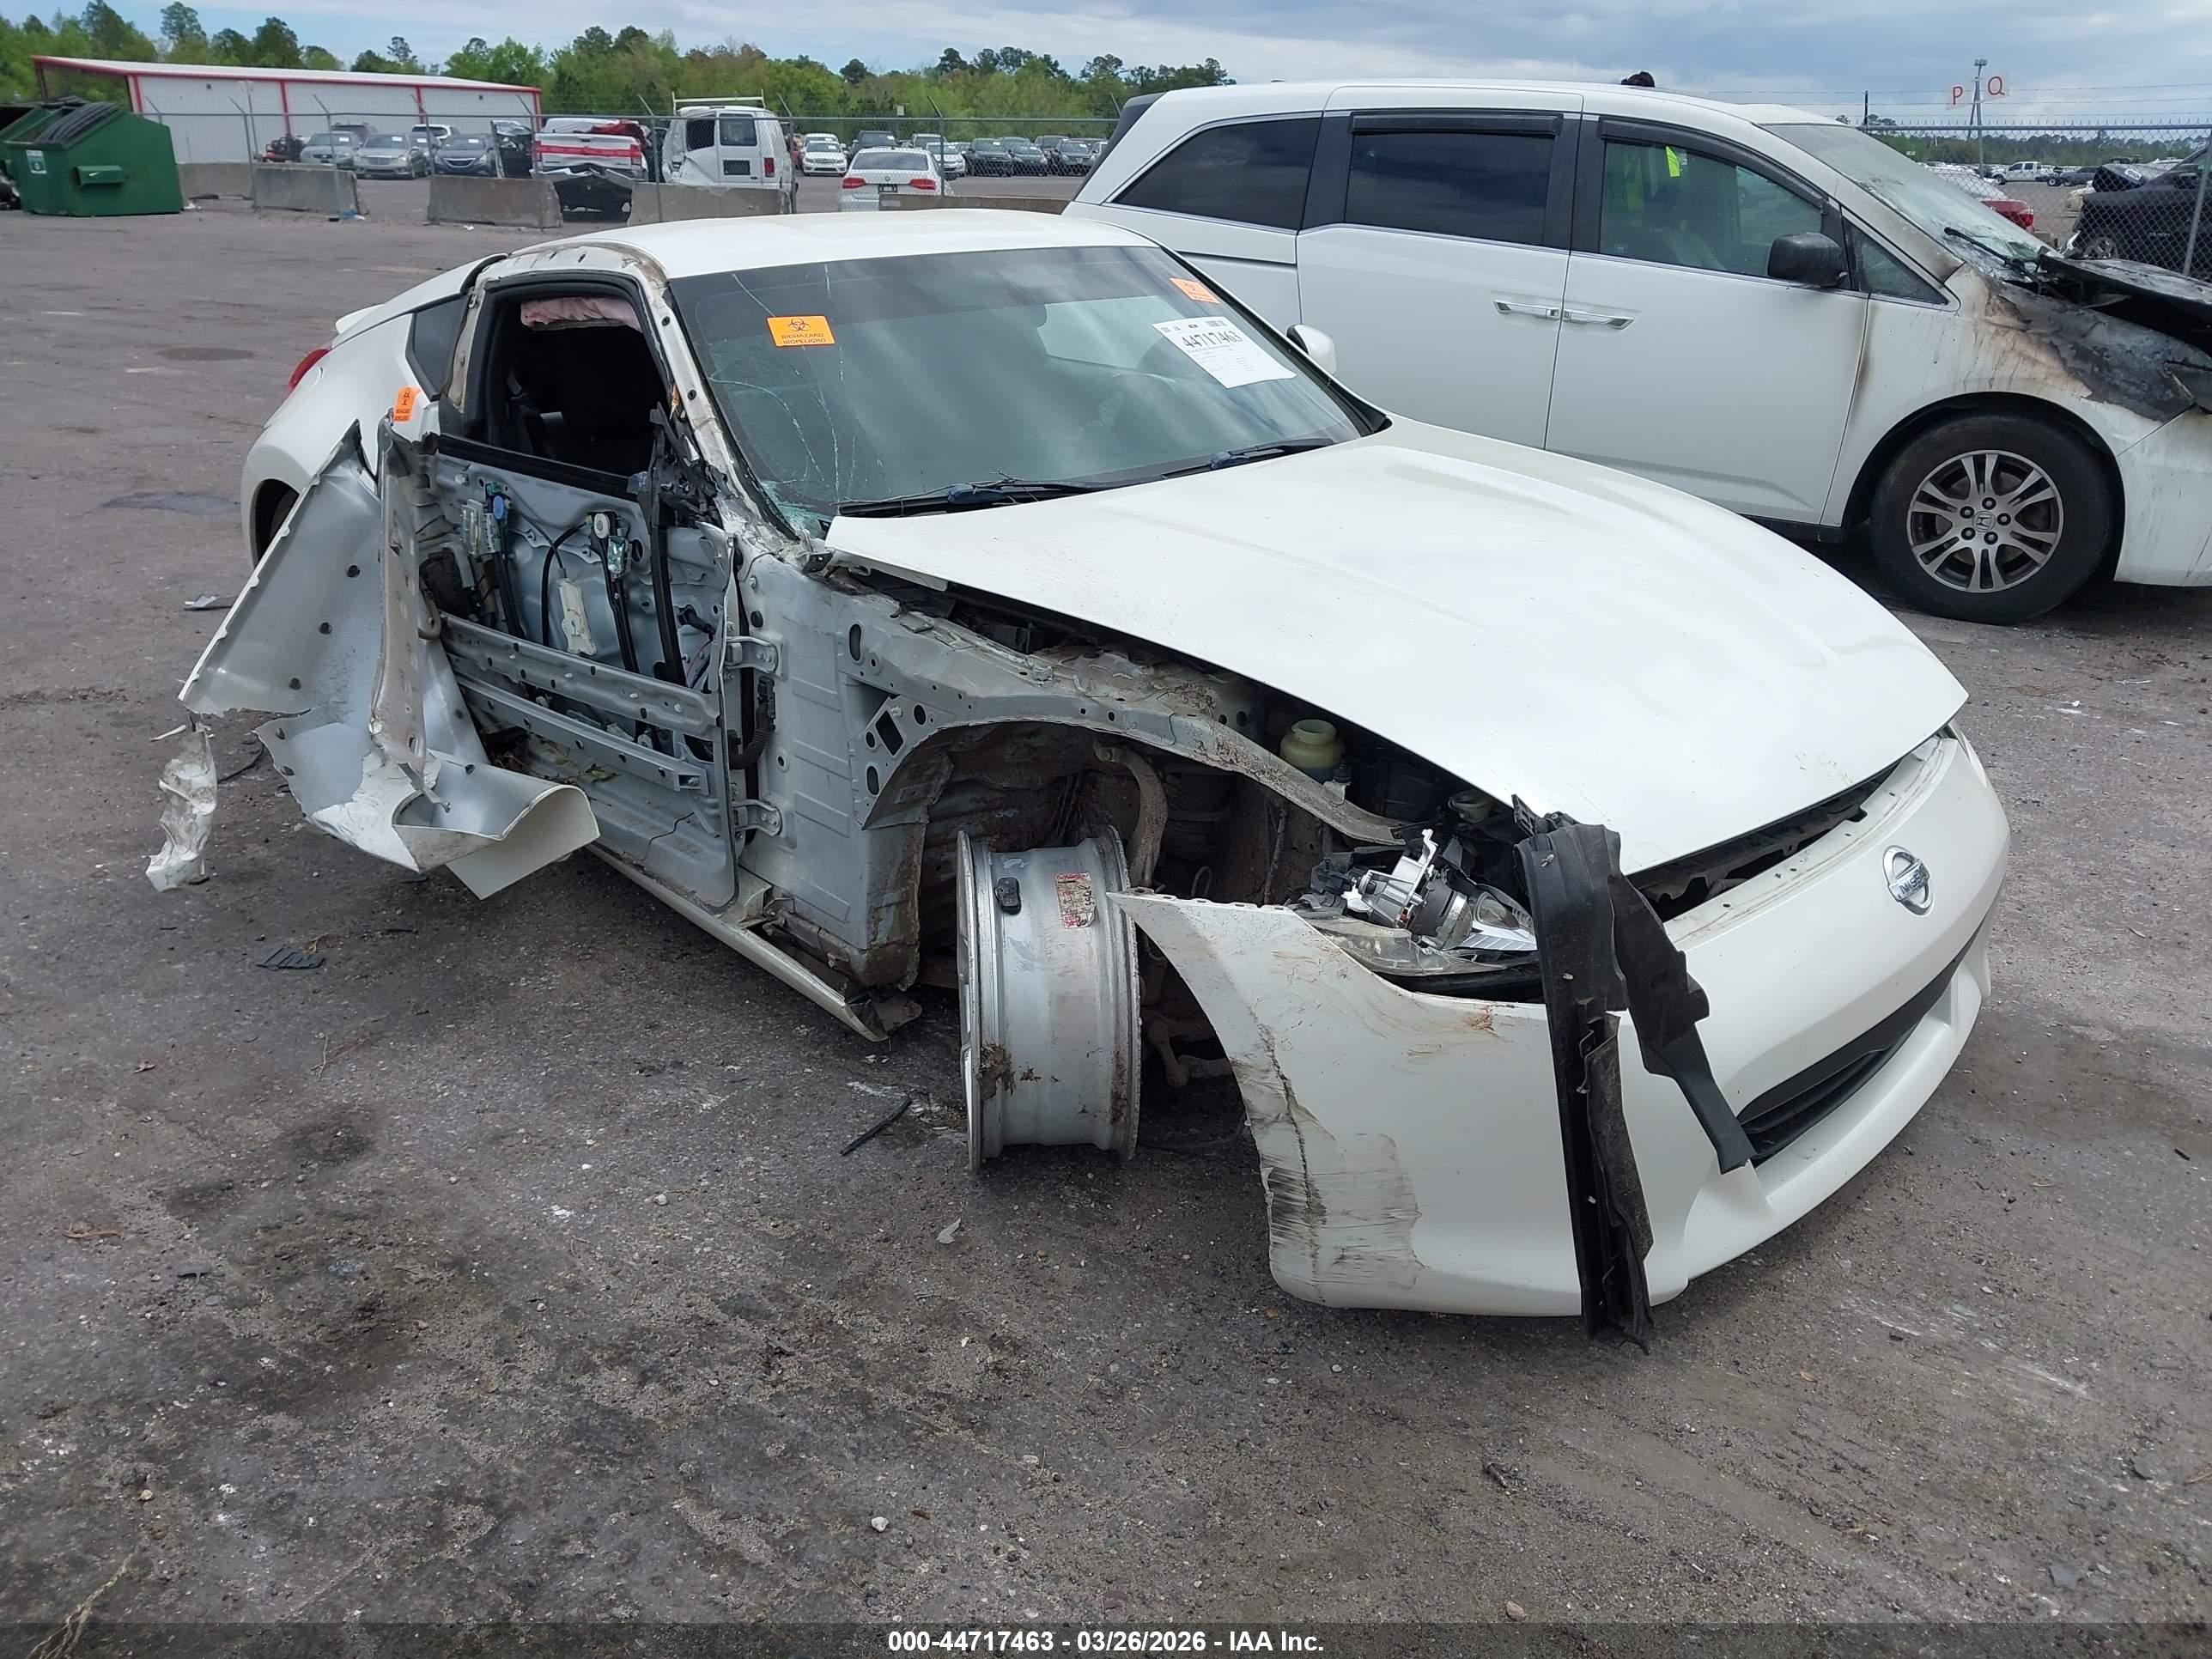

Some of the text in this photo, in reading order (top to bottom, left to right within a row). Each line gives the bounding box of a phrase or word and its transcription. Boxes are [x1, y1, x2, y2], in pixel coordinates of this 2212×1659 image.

[1988, 76, 2005, 95] Q
[1953, 86, 1963, 105] P
[1182, 331, 1243, 348] 44717463
